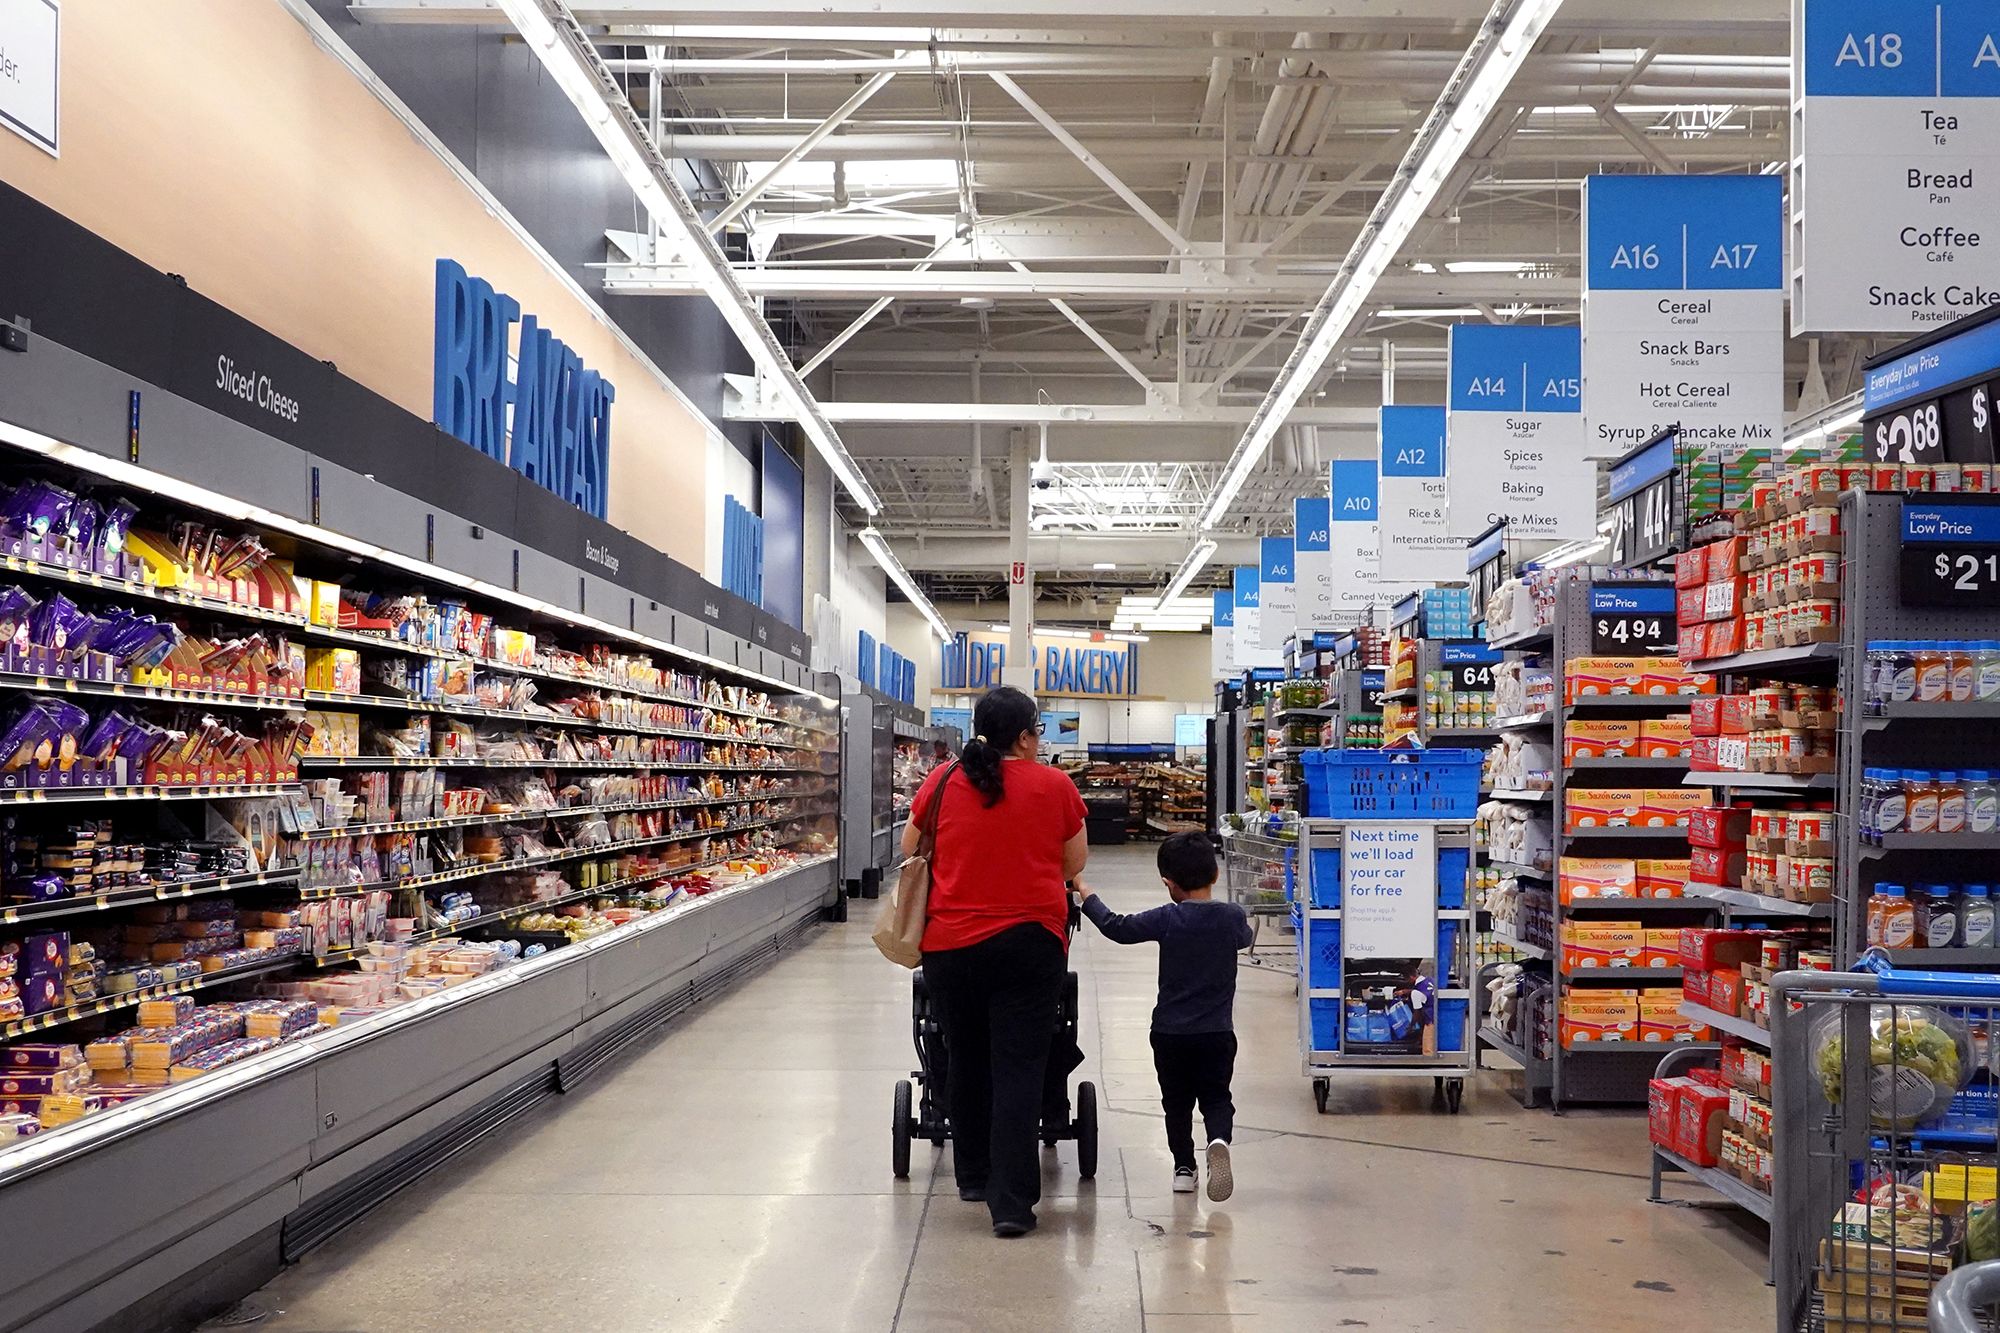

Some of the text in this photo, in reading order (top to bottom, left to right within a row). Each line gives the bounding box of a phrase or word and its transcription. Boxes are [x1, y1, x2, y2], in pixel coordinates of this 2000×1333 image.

[1835, 33, 1903, 68] A18
[1921, 110, 1958, 130] Tea
[1933, 134, 1946, 145] Té
[1907, 168, 1973, 188] Bread
[1929, 193, 1951, 204] Pan
[1900, 227, 1980, 247] Coffee
[1610, 244, 1659, 269] A16
[1710, 244, 1758, 269] A17
[1926, 252, 1954, 262] Café
[1868, 286, 1936, 306] Snack
[1658, 299, 1711, 314] Cereal
[1671, 317, 1698, 325] Cereal
[1640, 341, 1730, 355] Snack Bars
[1670, 358, 1699, 366] Snacks
[1871, 355, 1940, 390] Everyday Low Price
[216, 354, 299, 423] Sliced Cheese
[1468, 377, 1506, 396] A14
[1543, 379, 1580, 397] A15
[1640, 382, 1730, 397] Hot Cereal
[1652, 400, 1717, 408] Cereal Caliente
[1506, 418, 1542, 433] Sugar
[1598, 424, 1645, 442] Syrup
[1680, 424, 1736, 438] ancake
[1742, 424, 1772, 438] Mix
[1396, 448, 1425, 464] A12
[1504, 450, 1543, 465] Spices
[1502, 482, 1544, 496] Baking
[1344, 497, 1371, 511] A10
[1408, 508, 1442, 518] Rice &
[1522, 513, 1558, 526] Mixes
[1910, 512, 1941, 521] Everyday
[1910, 521, 1972, 534] Low Price
[1309, 531, 1327, 542] A8
[586, 540, 600, 563] Bacon
[1357, 549, 1374, 557] Box
[1272, 565, 1288, 575] A6
[1935, 552, 1997, 590] $21
[1244, 592, 1258, 600] A4
[1341, 592, 1375, 600] Canned
[1615, 599, 1637, 607] Price
[1312, 613, 1332, 621] Salad
[1598, 619, 1661, 643] $494
[1046, 646, 1127, 694] BAKERY
[1463, 667, 1489, 685] 64
[1350, 830, 1419, 841] Next time
[1385, 848, 1414, 859] load
[1350, 869, 1405, 881] your car
[1351, 884, 1402, 896] for free
[1350, 944, 1375, 952] Pickup
